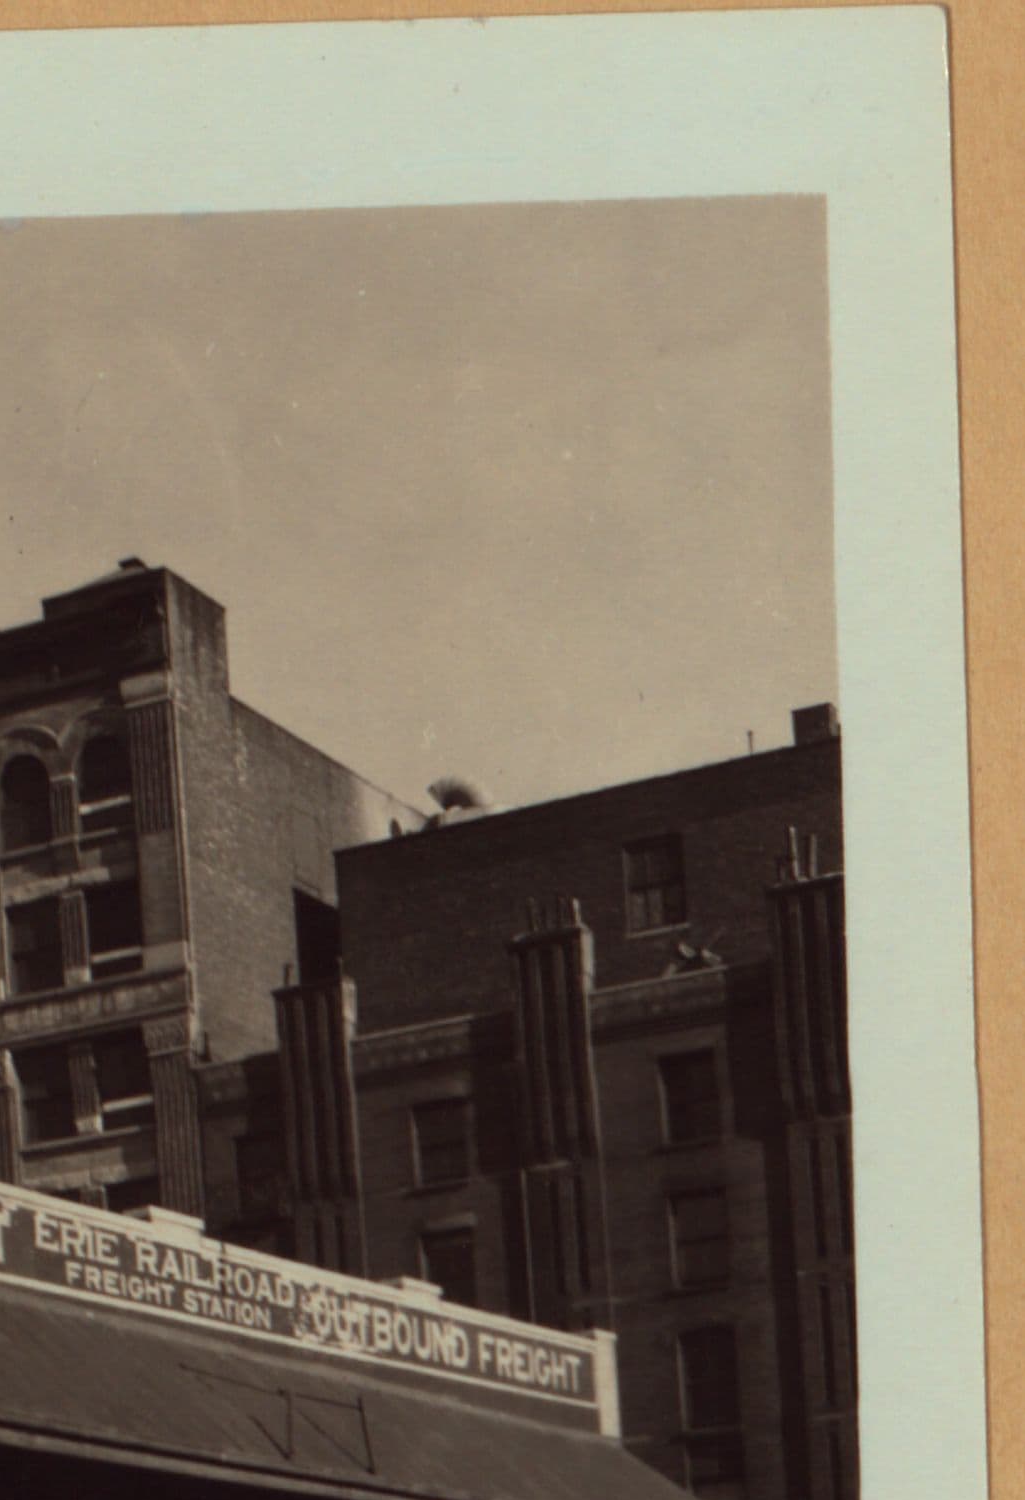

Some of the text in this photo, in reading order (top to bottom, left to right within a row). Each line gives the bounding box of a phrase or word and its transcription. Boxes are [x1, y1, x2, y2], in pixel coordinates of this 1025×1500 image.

[34, 1213, 296, 1307] ERIE RAILROAD
[66, 1262, 273, 1331] FREIGHT STATION
[310, 1293, 581, 1393] OUTBOUND FREIGHT
